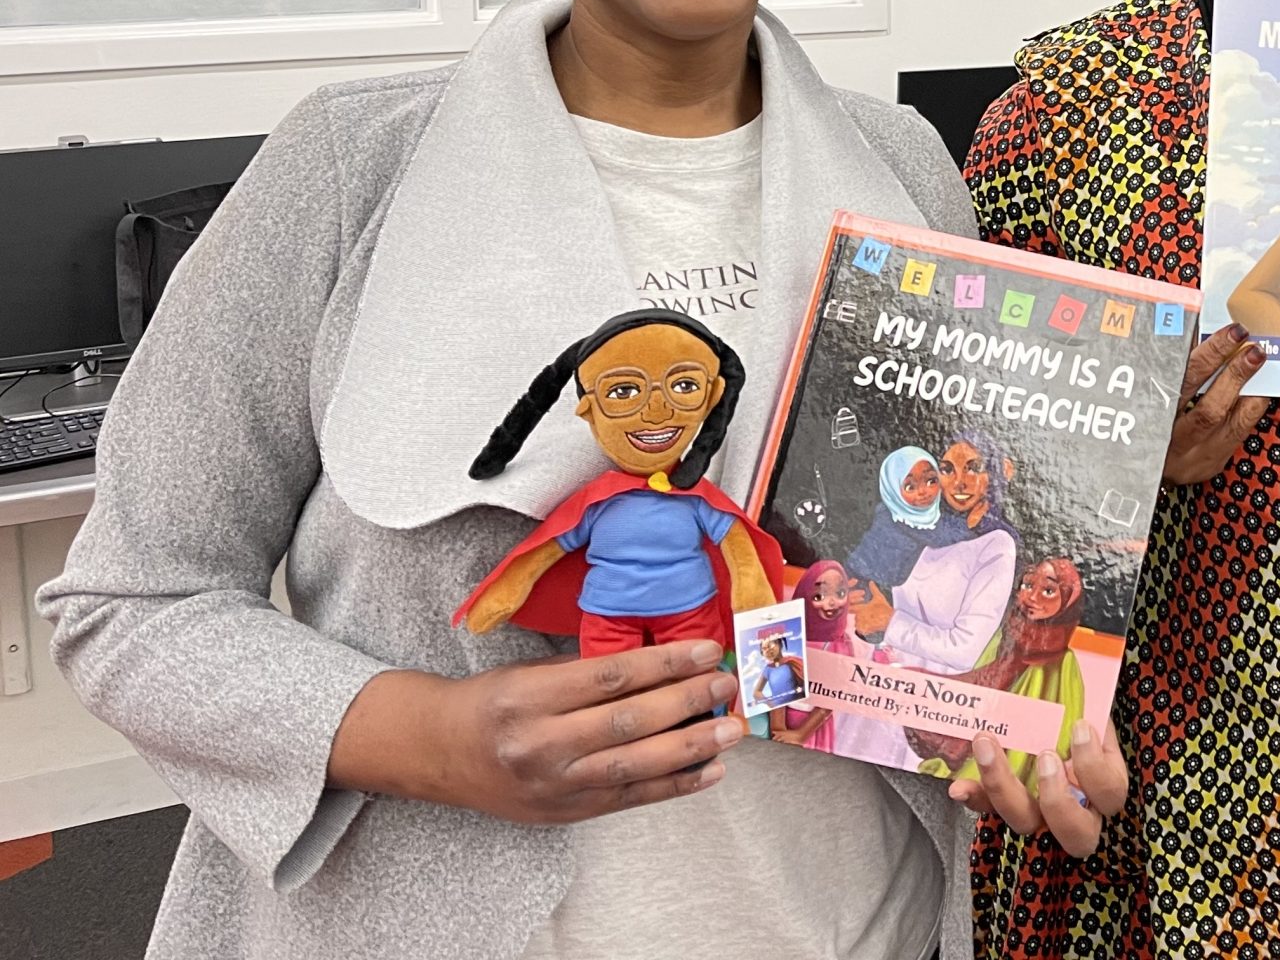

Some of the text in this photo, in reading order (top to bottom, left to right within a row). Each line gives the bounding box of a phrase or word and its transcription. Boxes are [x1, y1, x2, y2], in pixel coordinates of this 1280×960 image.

[1259, 340, 1279, 355] The
[1070, 353, 1100, 389] IS
[1107, 365, 1136, 398] A
[853, 355, 1137, 445] SCHOOLTEACHER
[808, 681, 881, 709] Illustrated
[914, 704, 968, 727] Victoria
[849, 663, 981, 709] Nasra Noor
